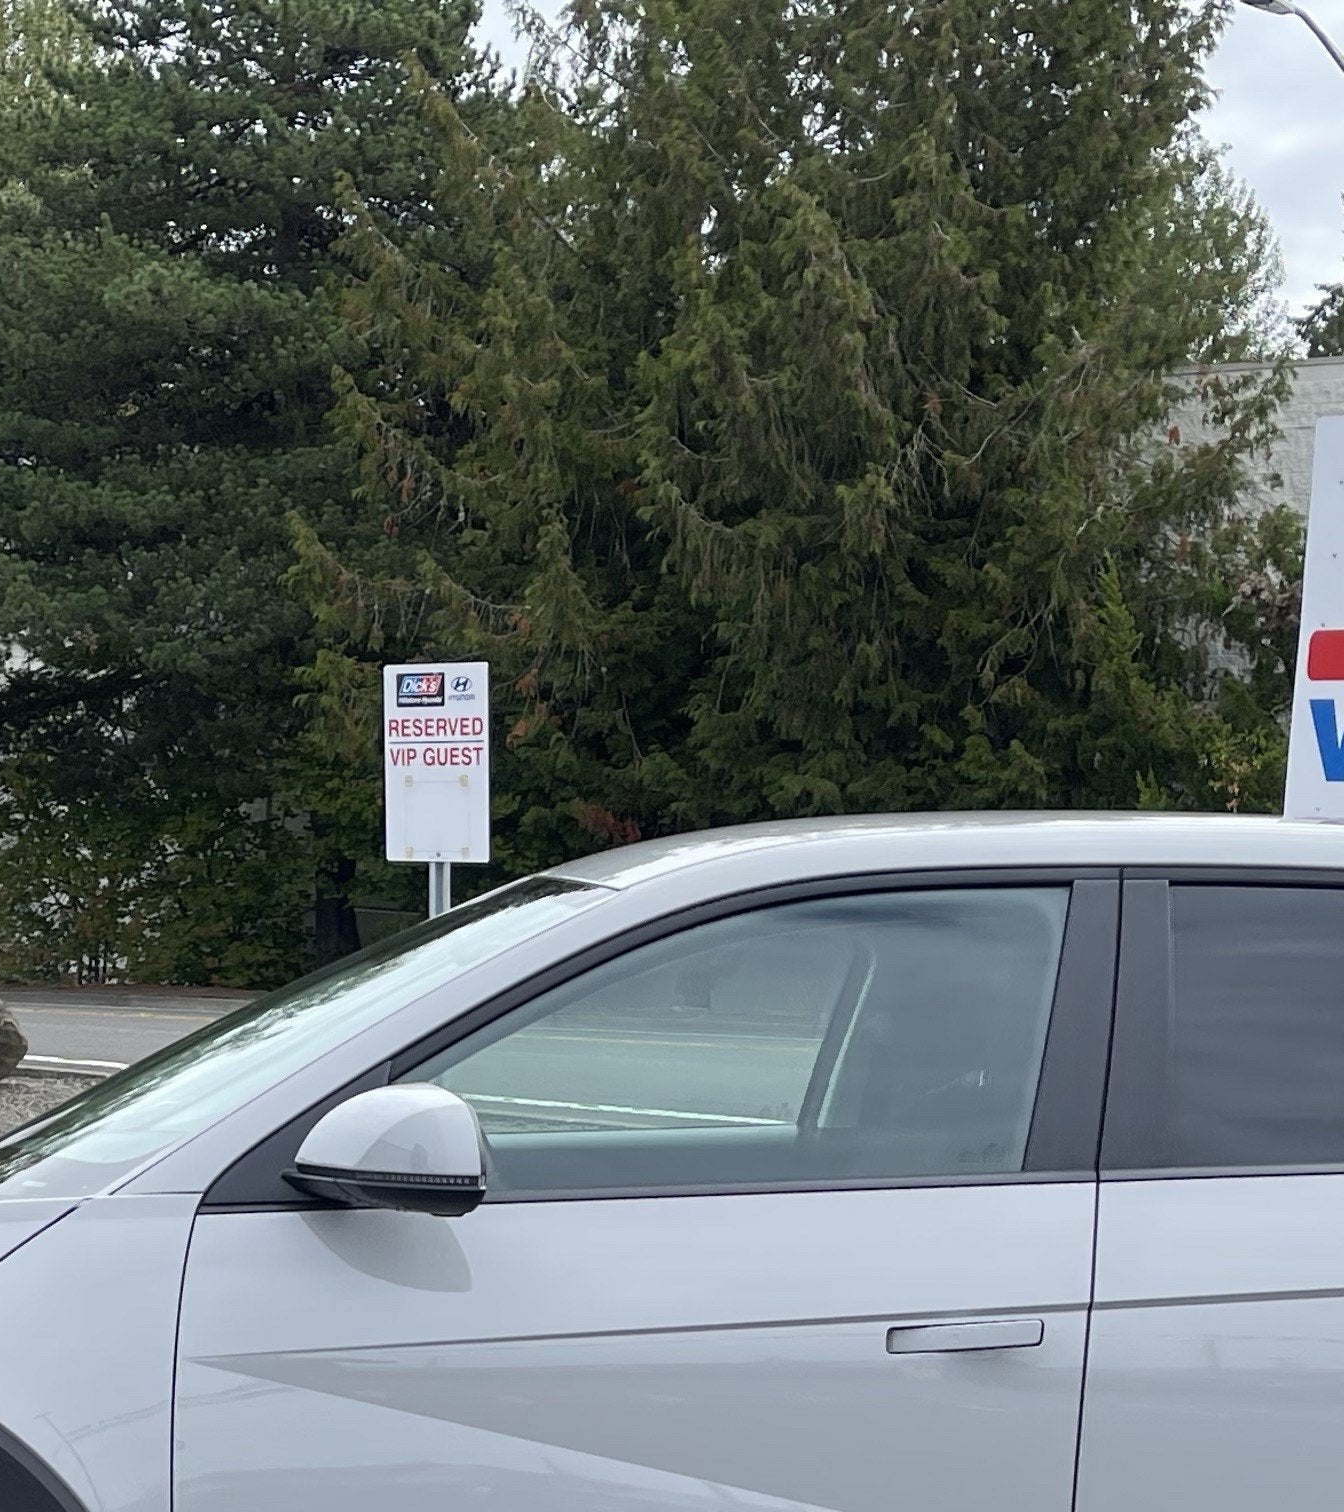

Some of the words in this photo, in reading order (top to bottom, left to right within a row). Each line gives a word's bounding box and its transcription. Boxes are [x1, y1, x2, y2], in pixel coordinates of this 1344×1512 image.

[388, 717, 484, 737] RESERVED
[389, 748, 417, 766] VIP
[423, 747, 484, 765] GUEST
